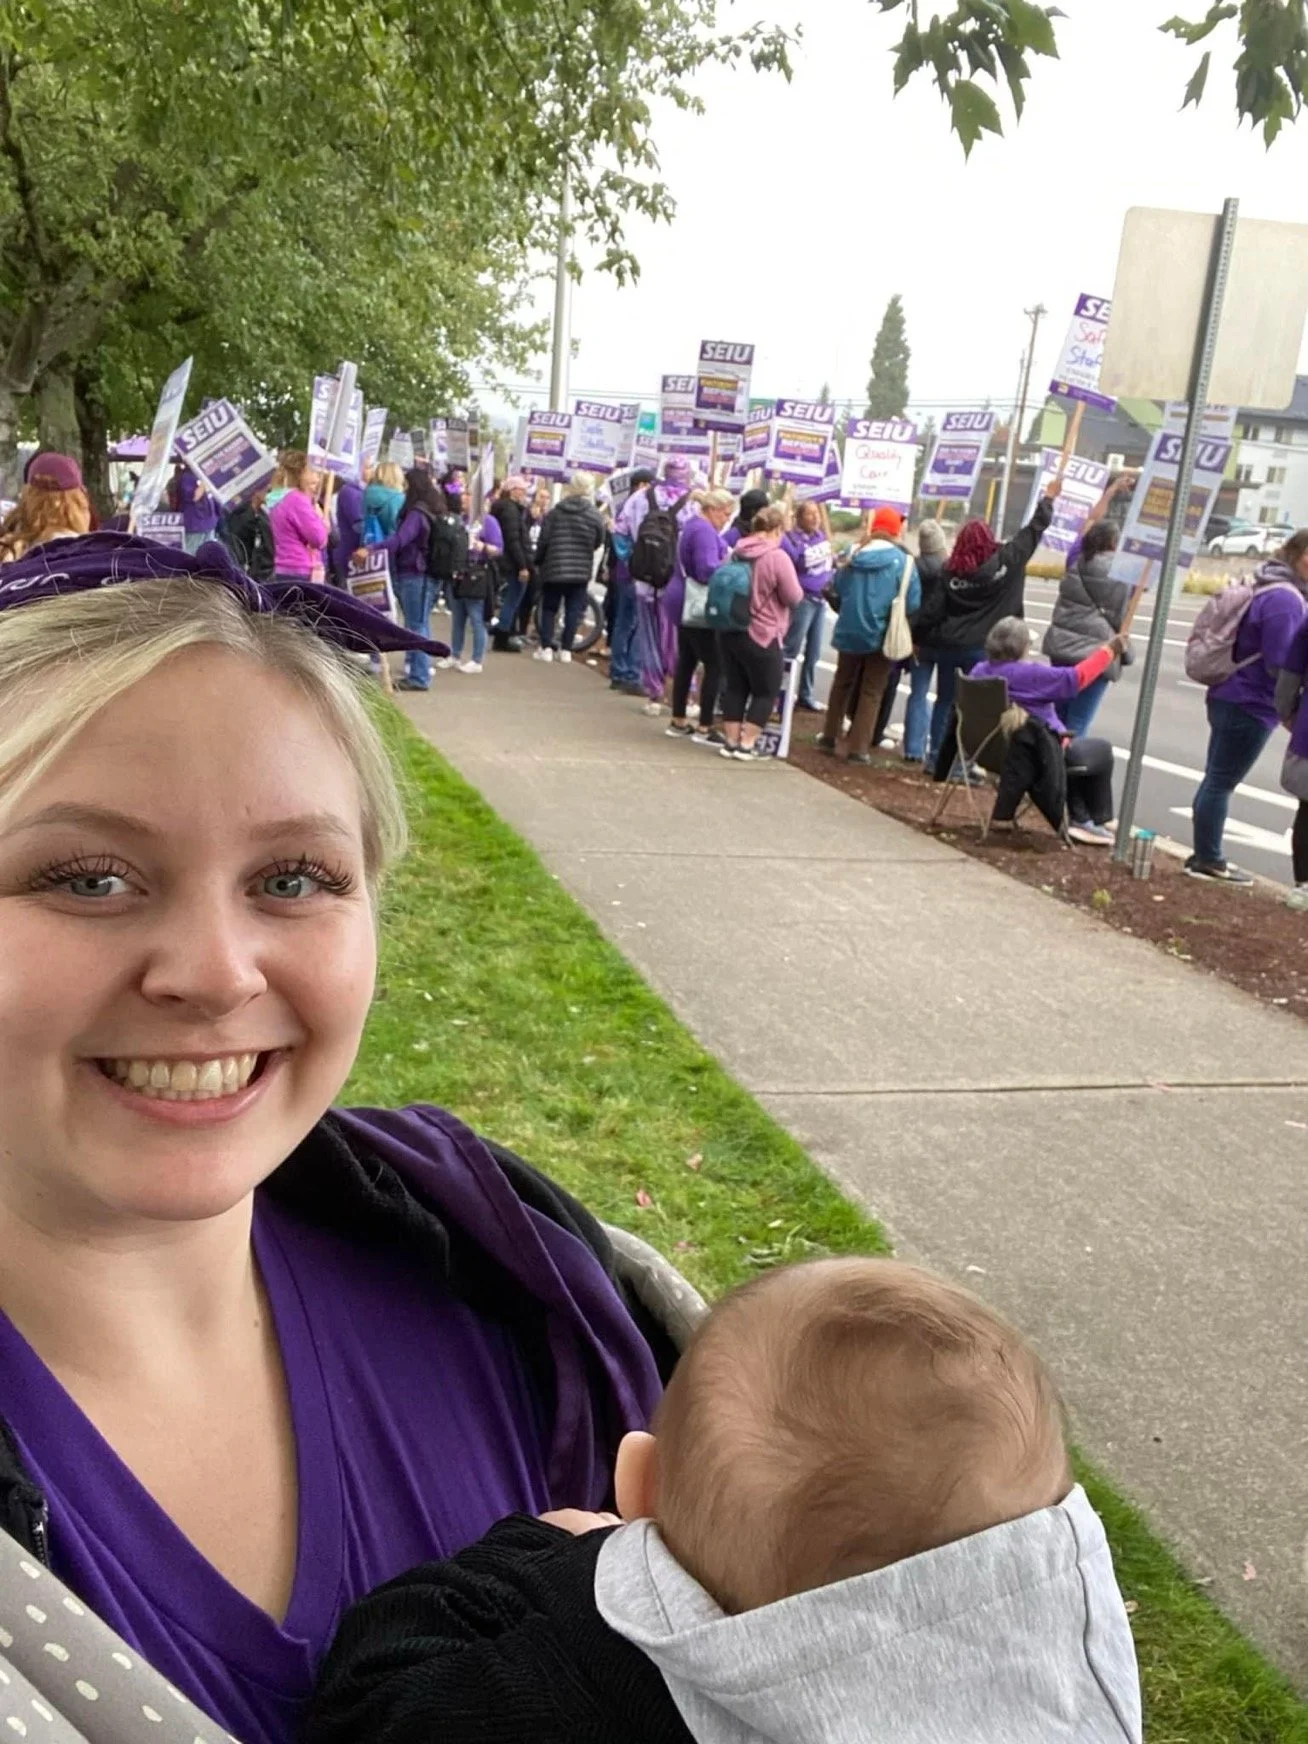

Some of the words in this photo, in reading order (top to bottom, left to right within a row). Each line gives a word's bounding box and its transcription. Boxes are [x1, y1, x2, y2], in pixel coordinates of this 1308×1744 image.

[1080, 298, 1112, 321] SE
[702, 342, 750, 362] SEIU
[665, 376, 694, 392] SEI
[531, 412, 569, 428] SEIU
[577, 403, 620, 422] SEIU
[780, 401, 832, 422] SEIU
[946, 414, 990, 429] SEIU
[182, 405, 229, 450] SEIU
[853, 421, 913, 441] SEIU
[1160, 437, 1226, 467] SIU
[143, 514, 181, 526] SEIU
[348, 553, 383, 576] SIU
